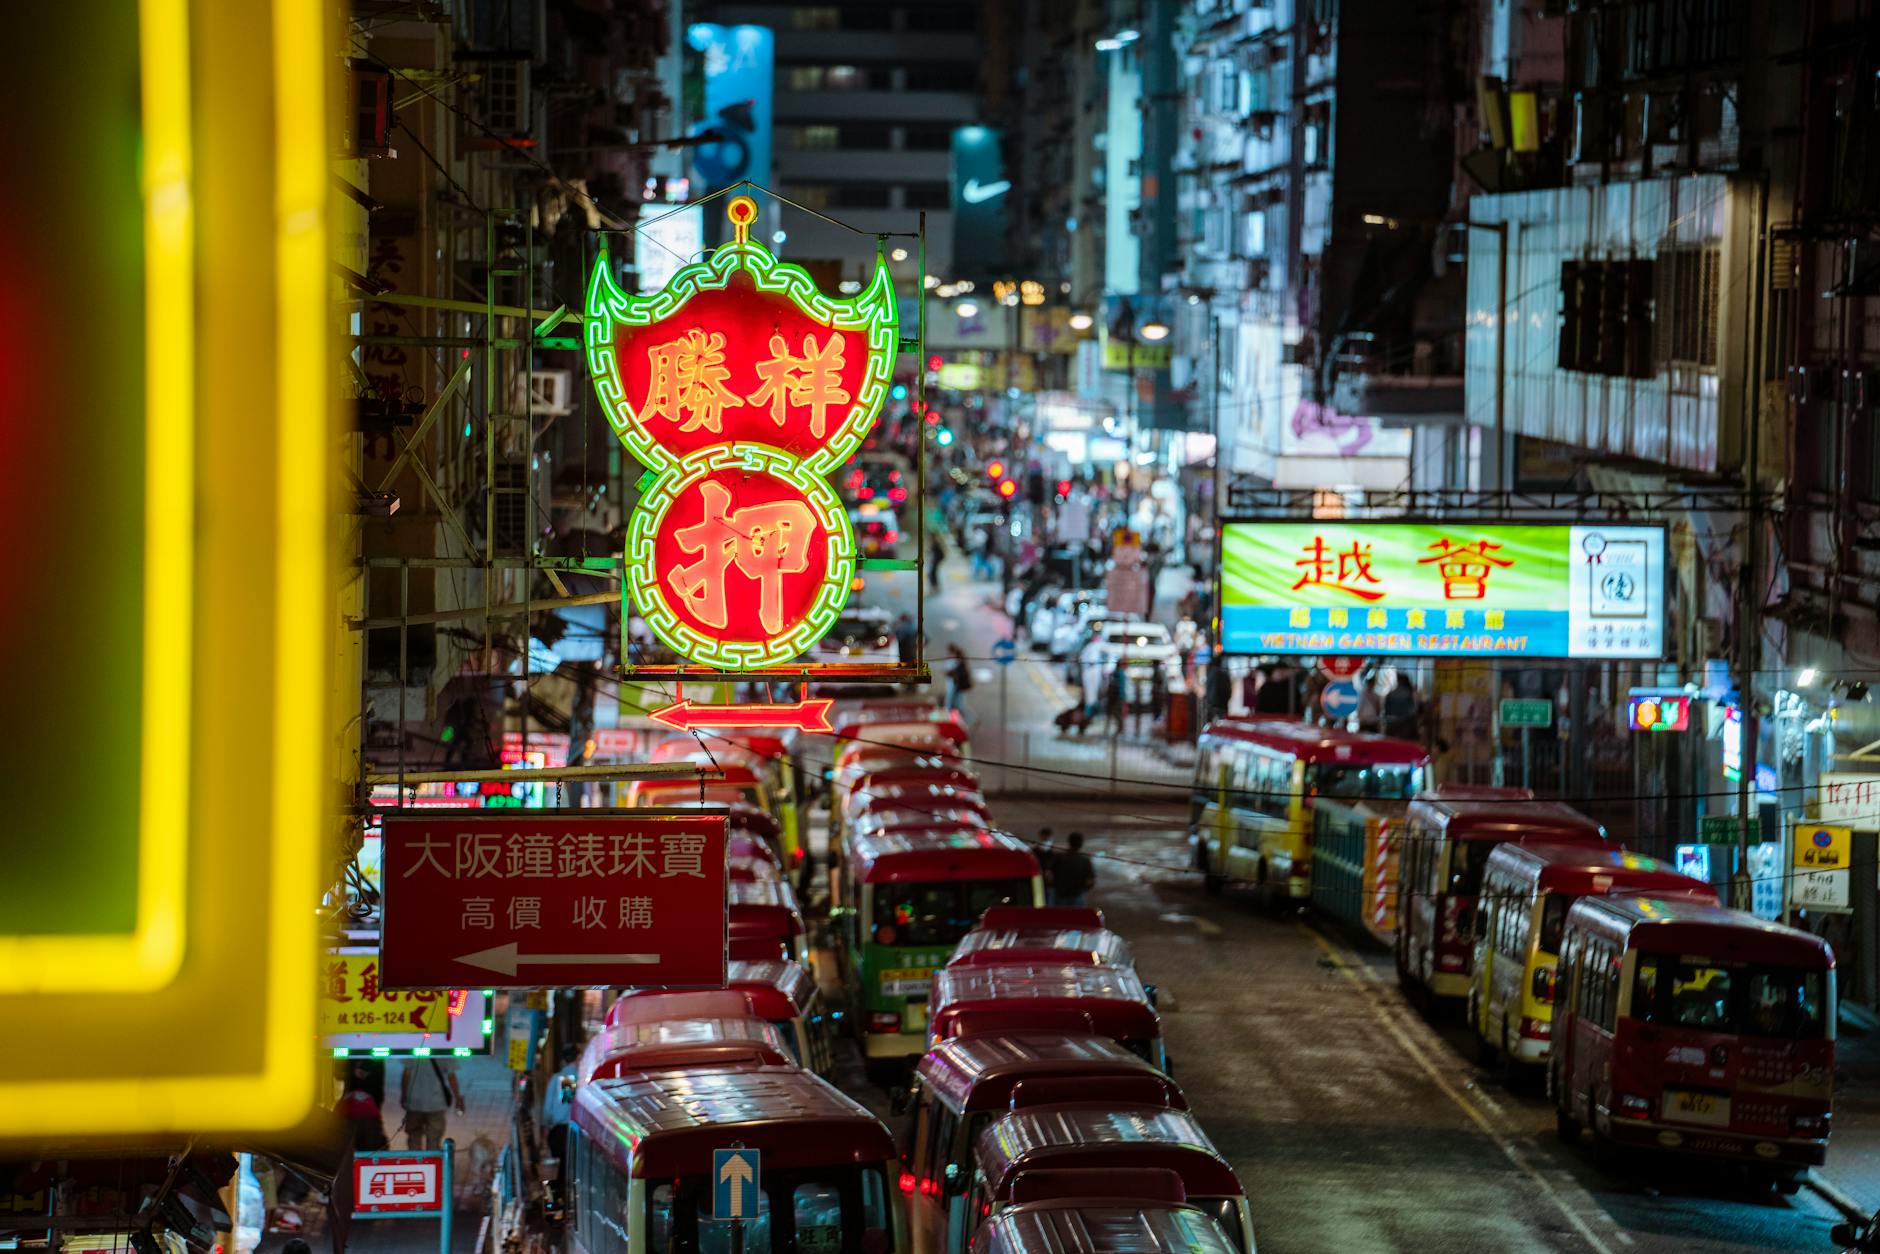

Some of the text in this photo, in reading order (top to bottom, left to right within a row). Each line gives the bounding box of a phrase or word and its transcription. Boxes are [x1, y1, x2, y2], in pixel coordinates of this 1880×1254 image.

[667, 479, 817, 635] 押
[1261, 633, 1529, 651] VIETNAM GARDEN RESTAURANT
[403, 832, 707, 879] 大阪鐘錶珠寶
[1808, 872, 1834, 885] End
[461, 896, 654, 930] 高價 收購
[352, 1012, 406, 1025] 126-124
